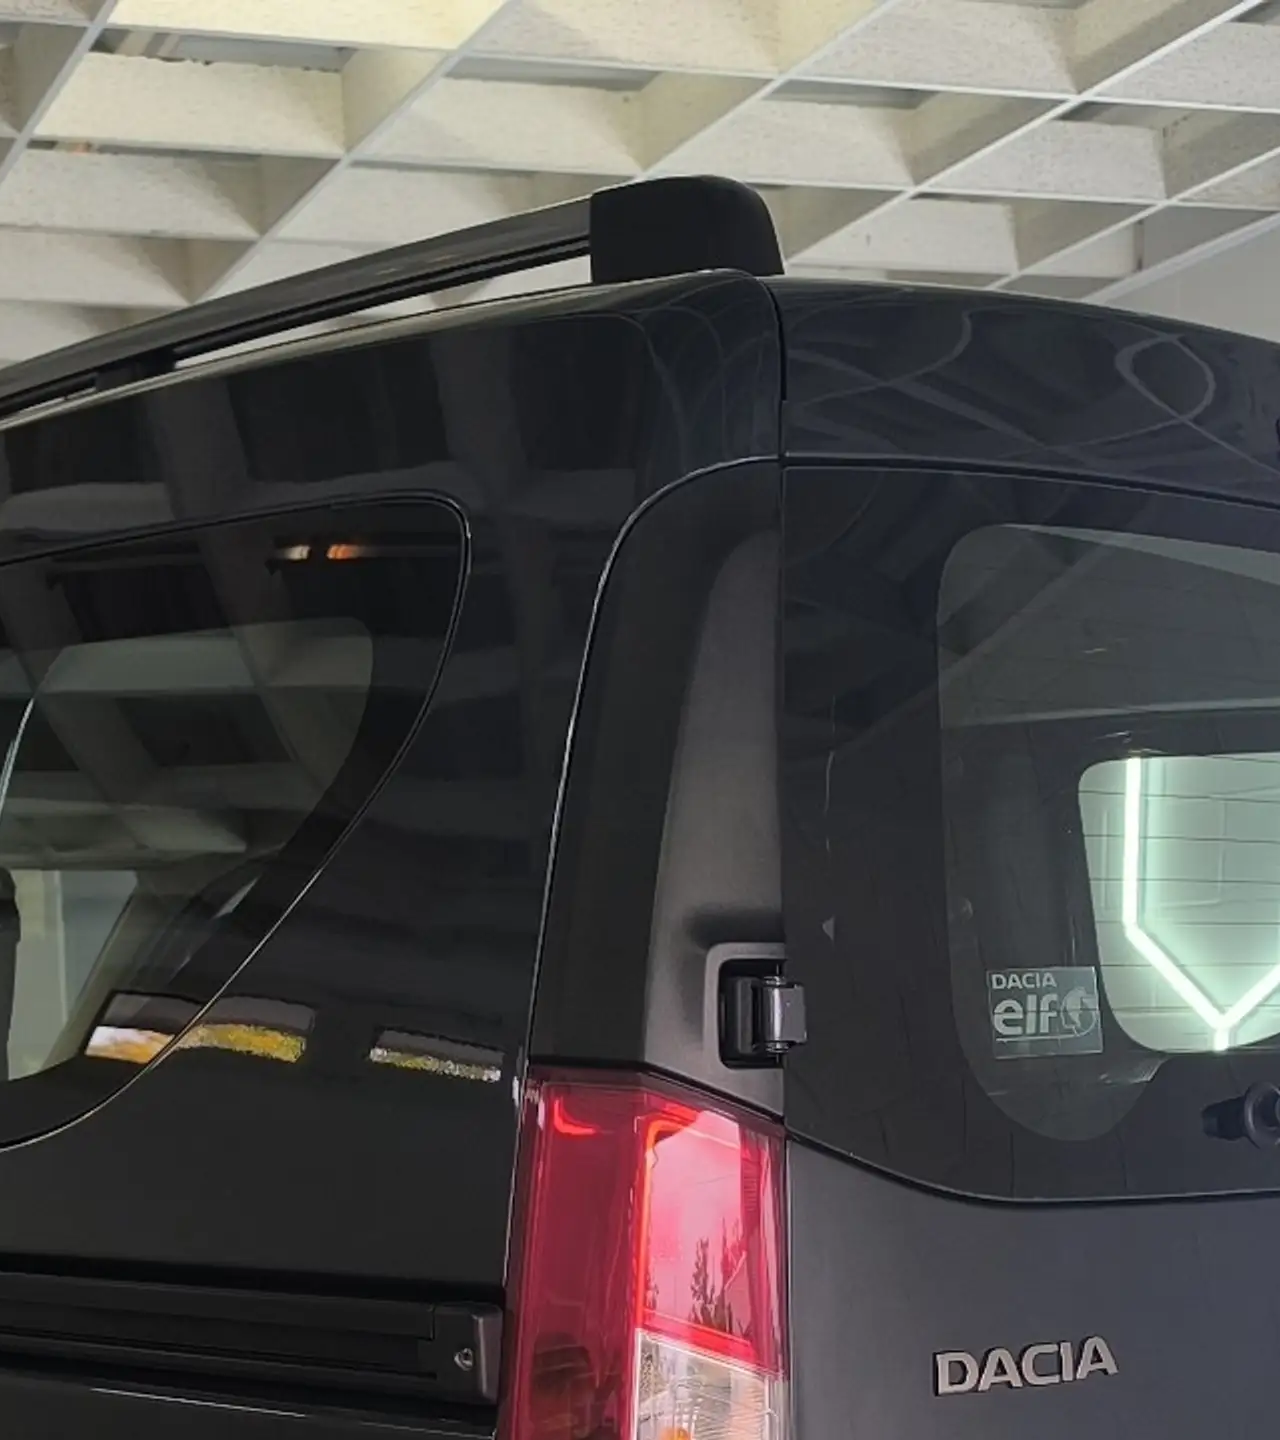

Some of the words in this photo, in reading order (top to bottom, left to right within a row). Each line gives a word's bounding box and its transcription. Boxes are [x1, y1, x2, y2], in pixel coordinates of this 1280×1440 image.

[991, 972, 1057, 989] DACIA
[993, 993, 1058, 1036] elf
[933, 1335, 1118, 1396] DACIA
